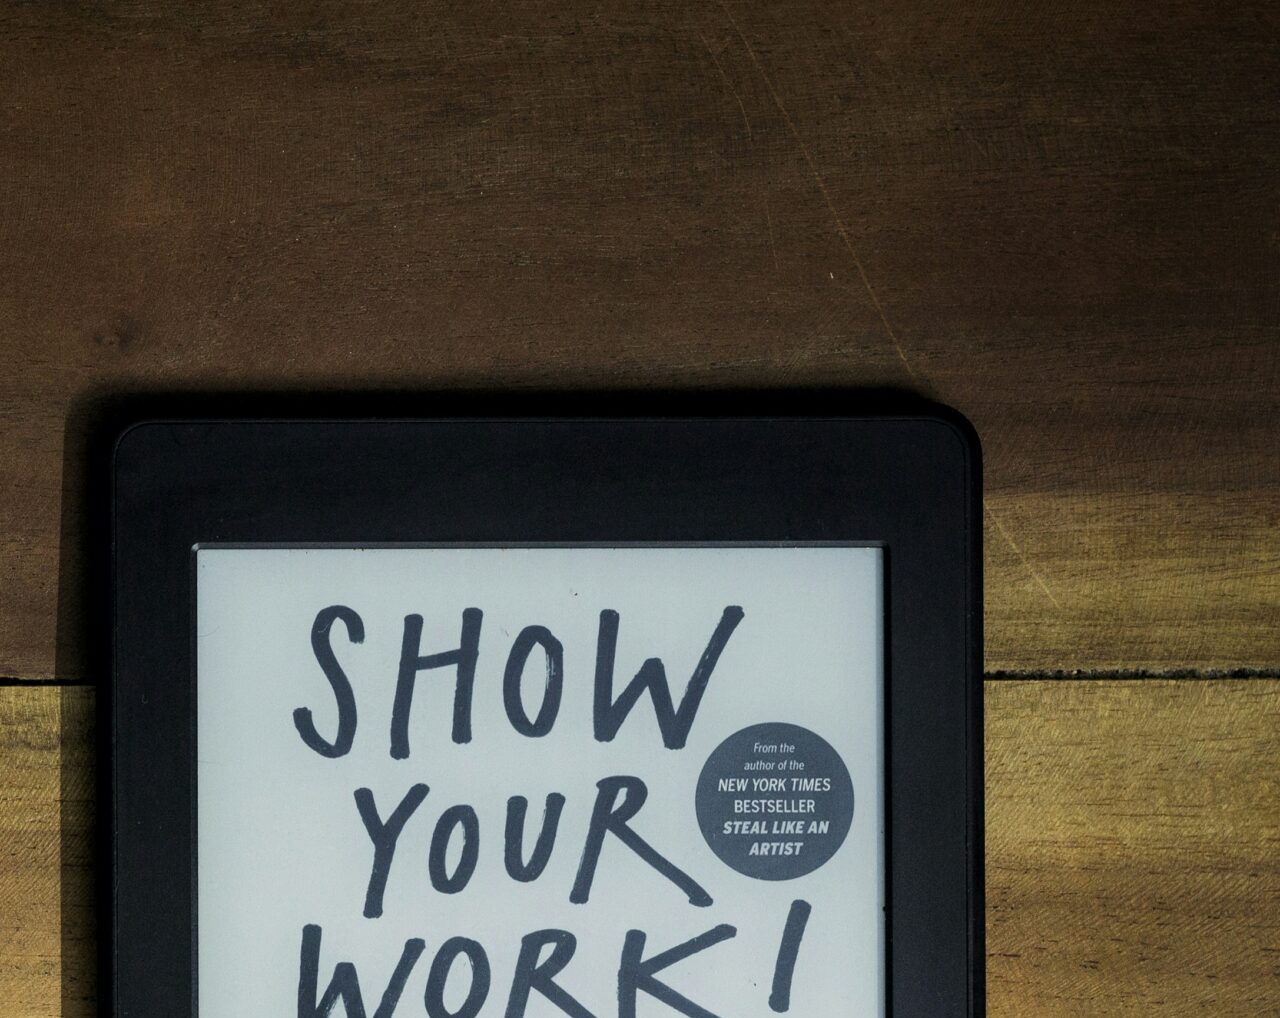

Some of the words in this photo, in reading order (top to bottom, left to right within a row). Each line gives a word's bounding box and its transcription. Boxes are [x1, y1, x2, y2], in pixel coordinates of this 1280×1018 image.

[293, 604, 745, 761] SHOW
[753, 742, 777, 754] From
[779, 742, 796, 754] the
[743, 759, 775, 771] author
[777, 759, 788, 772] of
[789, 759, 805, 771] the
[718, 777, 749, 793] NEW
[752, 777, 787, 792] YORK
[791, 777, 831, 792] TIMES
[734, 799, 816, 814] BESTSELLER
[722, 820, 769, 835] STEAL
[771, 820, 805, 835] LIKE
[807, 820, 830, 835] AN
[353, 775, 714, 919] YOUR
[748, 841, 804, 856] ARTIST
